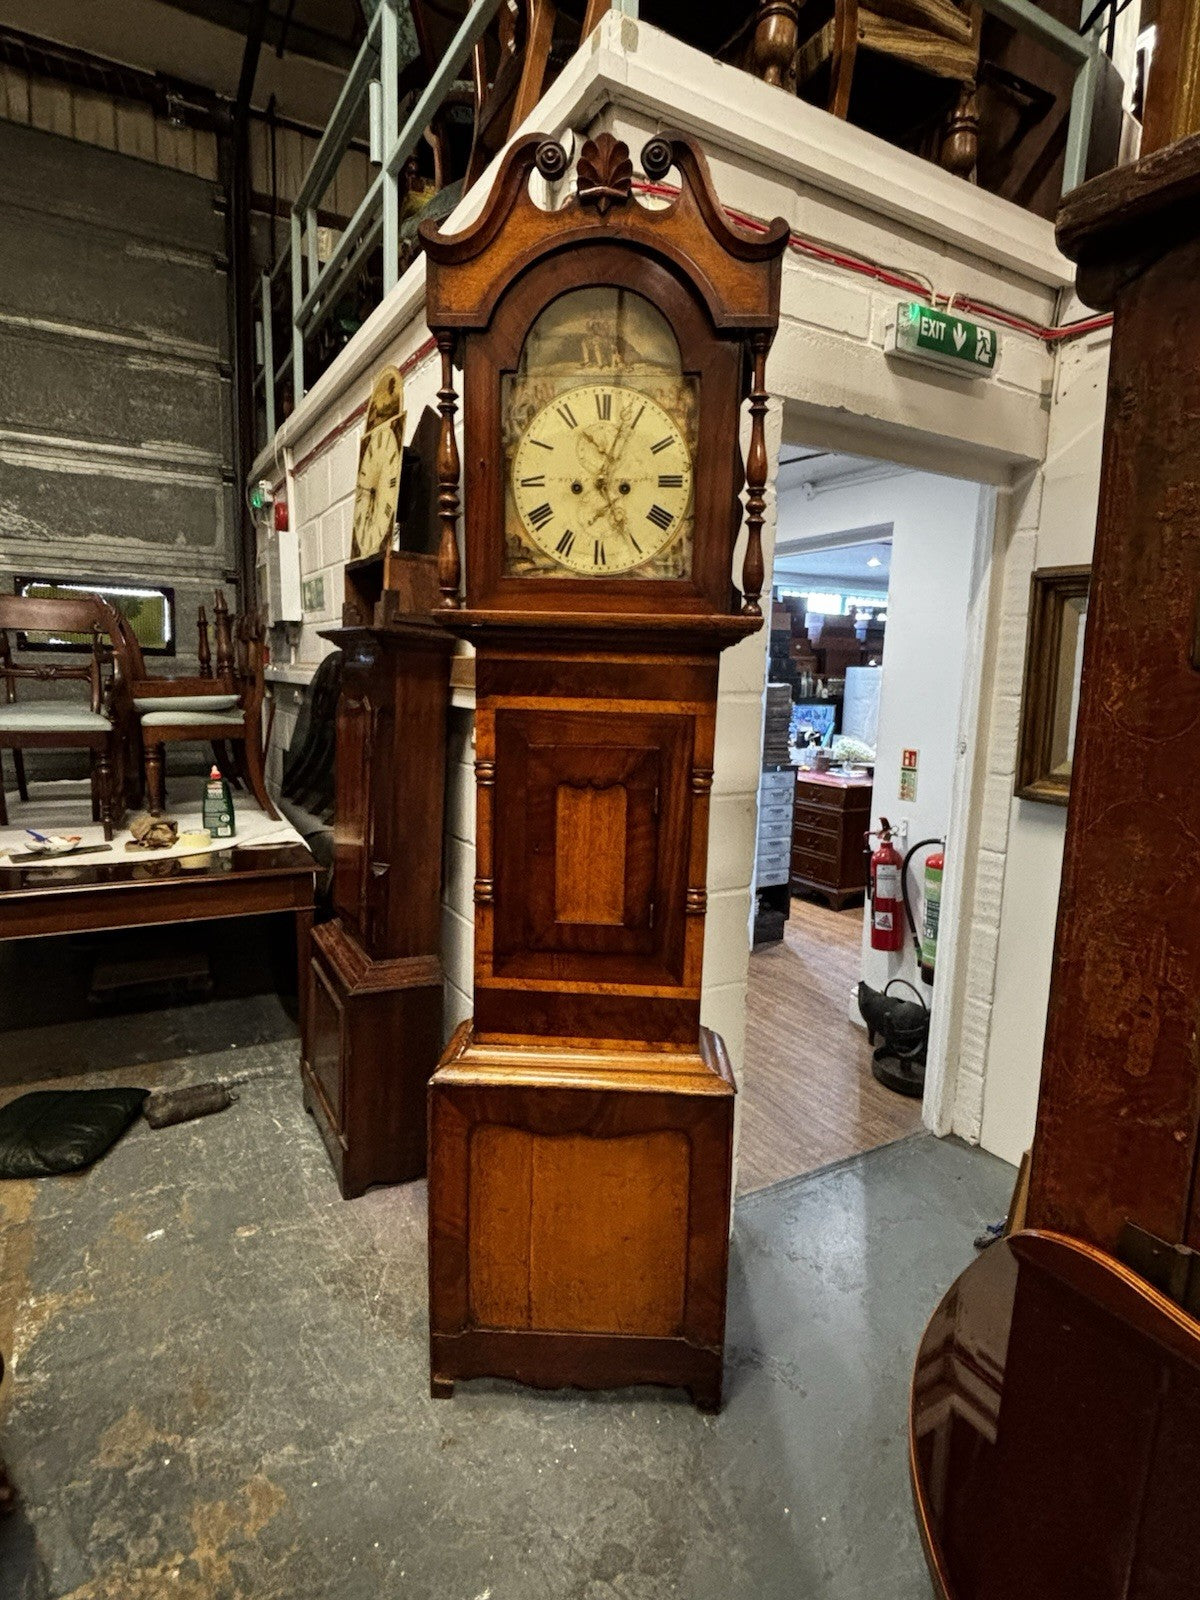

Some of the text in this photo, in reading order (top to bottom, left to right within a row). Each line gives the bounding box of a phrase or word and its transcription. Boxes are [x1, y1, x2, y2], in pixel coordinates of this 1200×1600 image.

[921, 316, 946, 341] EXIT
[631, 405, 645, 430] I
[650, 435, 675, 455] II
[658, 473, 683, 488] III
[645, 503, 675, 531] IIII
